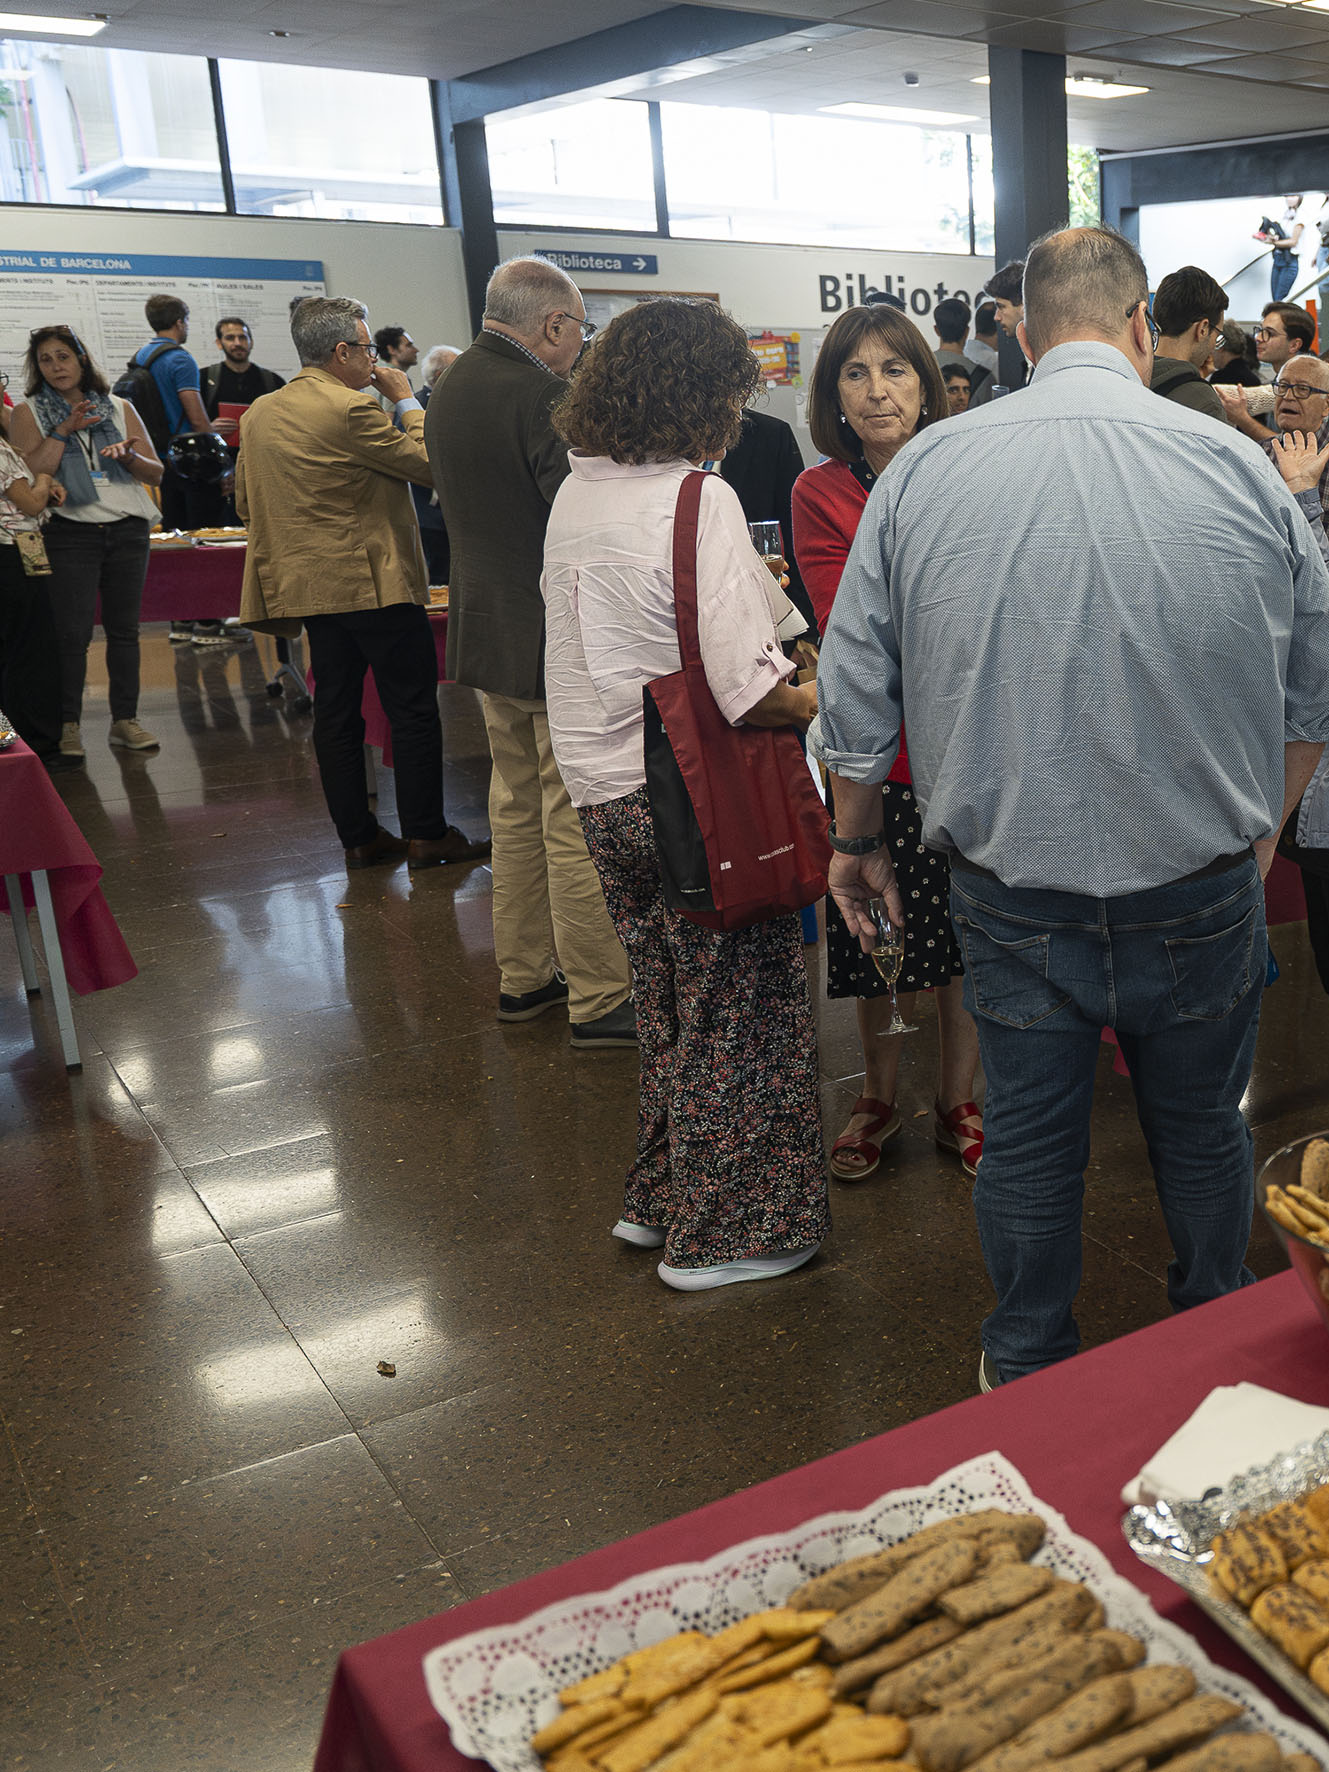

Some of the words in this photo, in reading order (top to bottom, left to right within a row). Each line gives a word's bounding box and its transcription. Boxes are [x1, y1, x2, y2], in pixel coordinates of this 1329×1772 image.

[40, 257, 57, 268] DE
[61, 258, 132, 270] BARCELONA
[547, 253, 622, 270] Biblioteca
